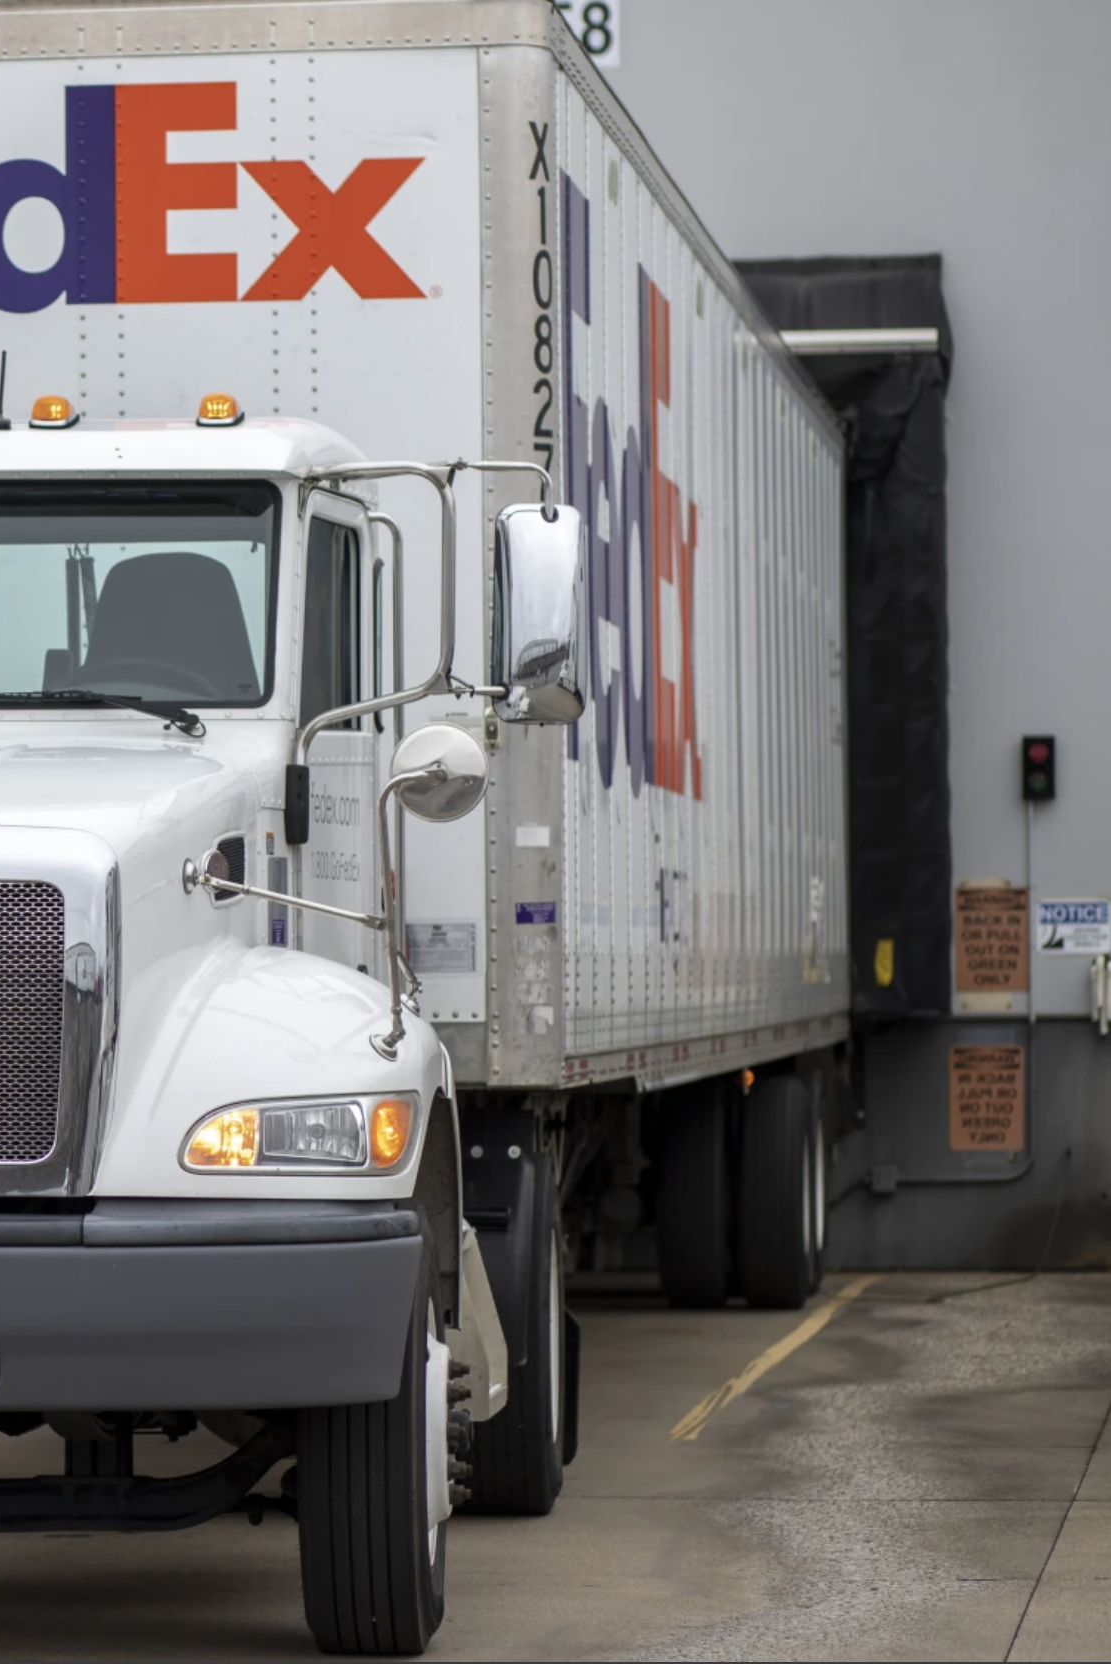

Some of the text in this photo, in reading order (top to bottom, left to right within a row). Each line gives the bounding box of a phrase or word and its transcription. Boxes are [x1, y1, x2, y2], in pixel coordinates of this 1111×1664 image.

[310, 782, 361, 827] fedex.com
[1040, 904, 1107, 922] NOTICE
[963, 915, 1021, 926] BACK IN
[961, 929, 1021, 940] OR PULL
[965, 944, 1020, 956] OUT ON
[968, 958, 1018, 970] GREEN
[973, 973, 1011, 985] ONLY
